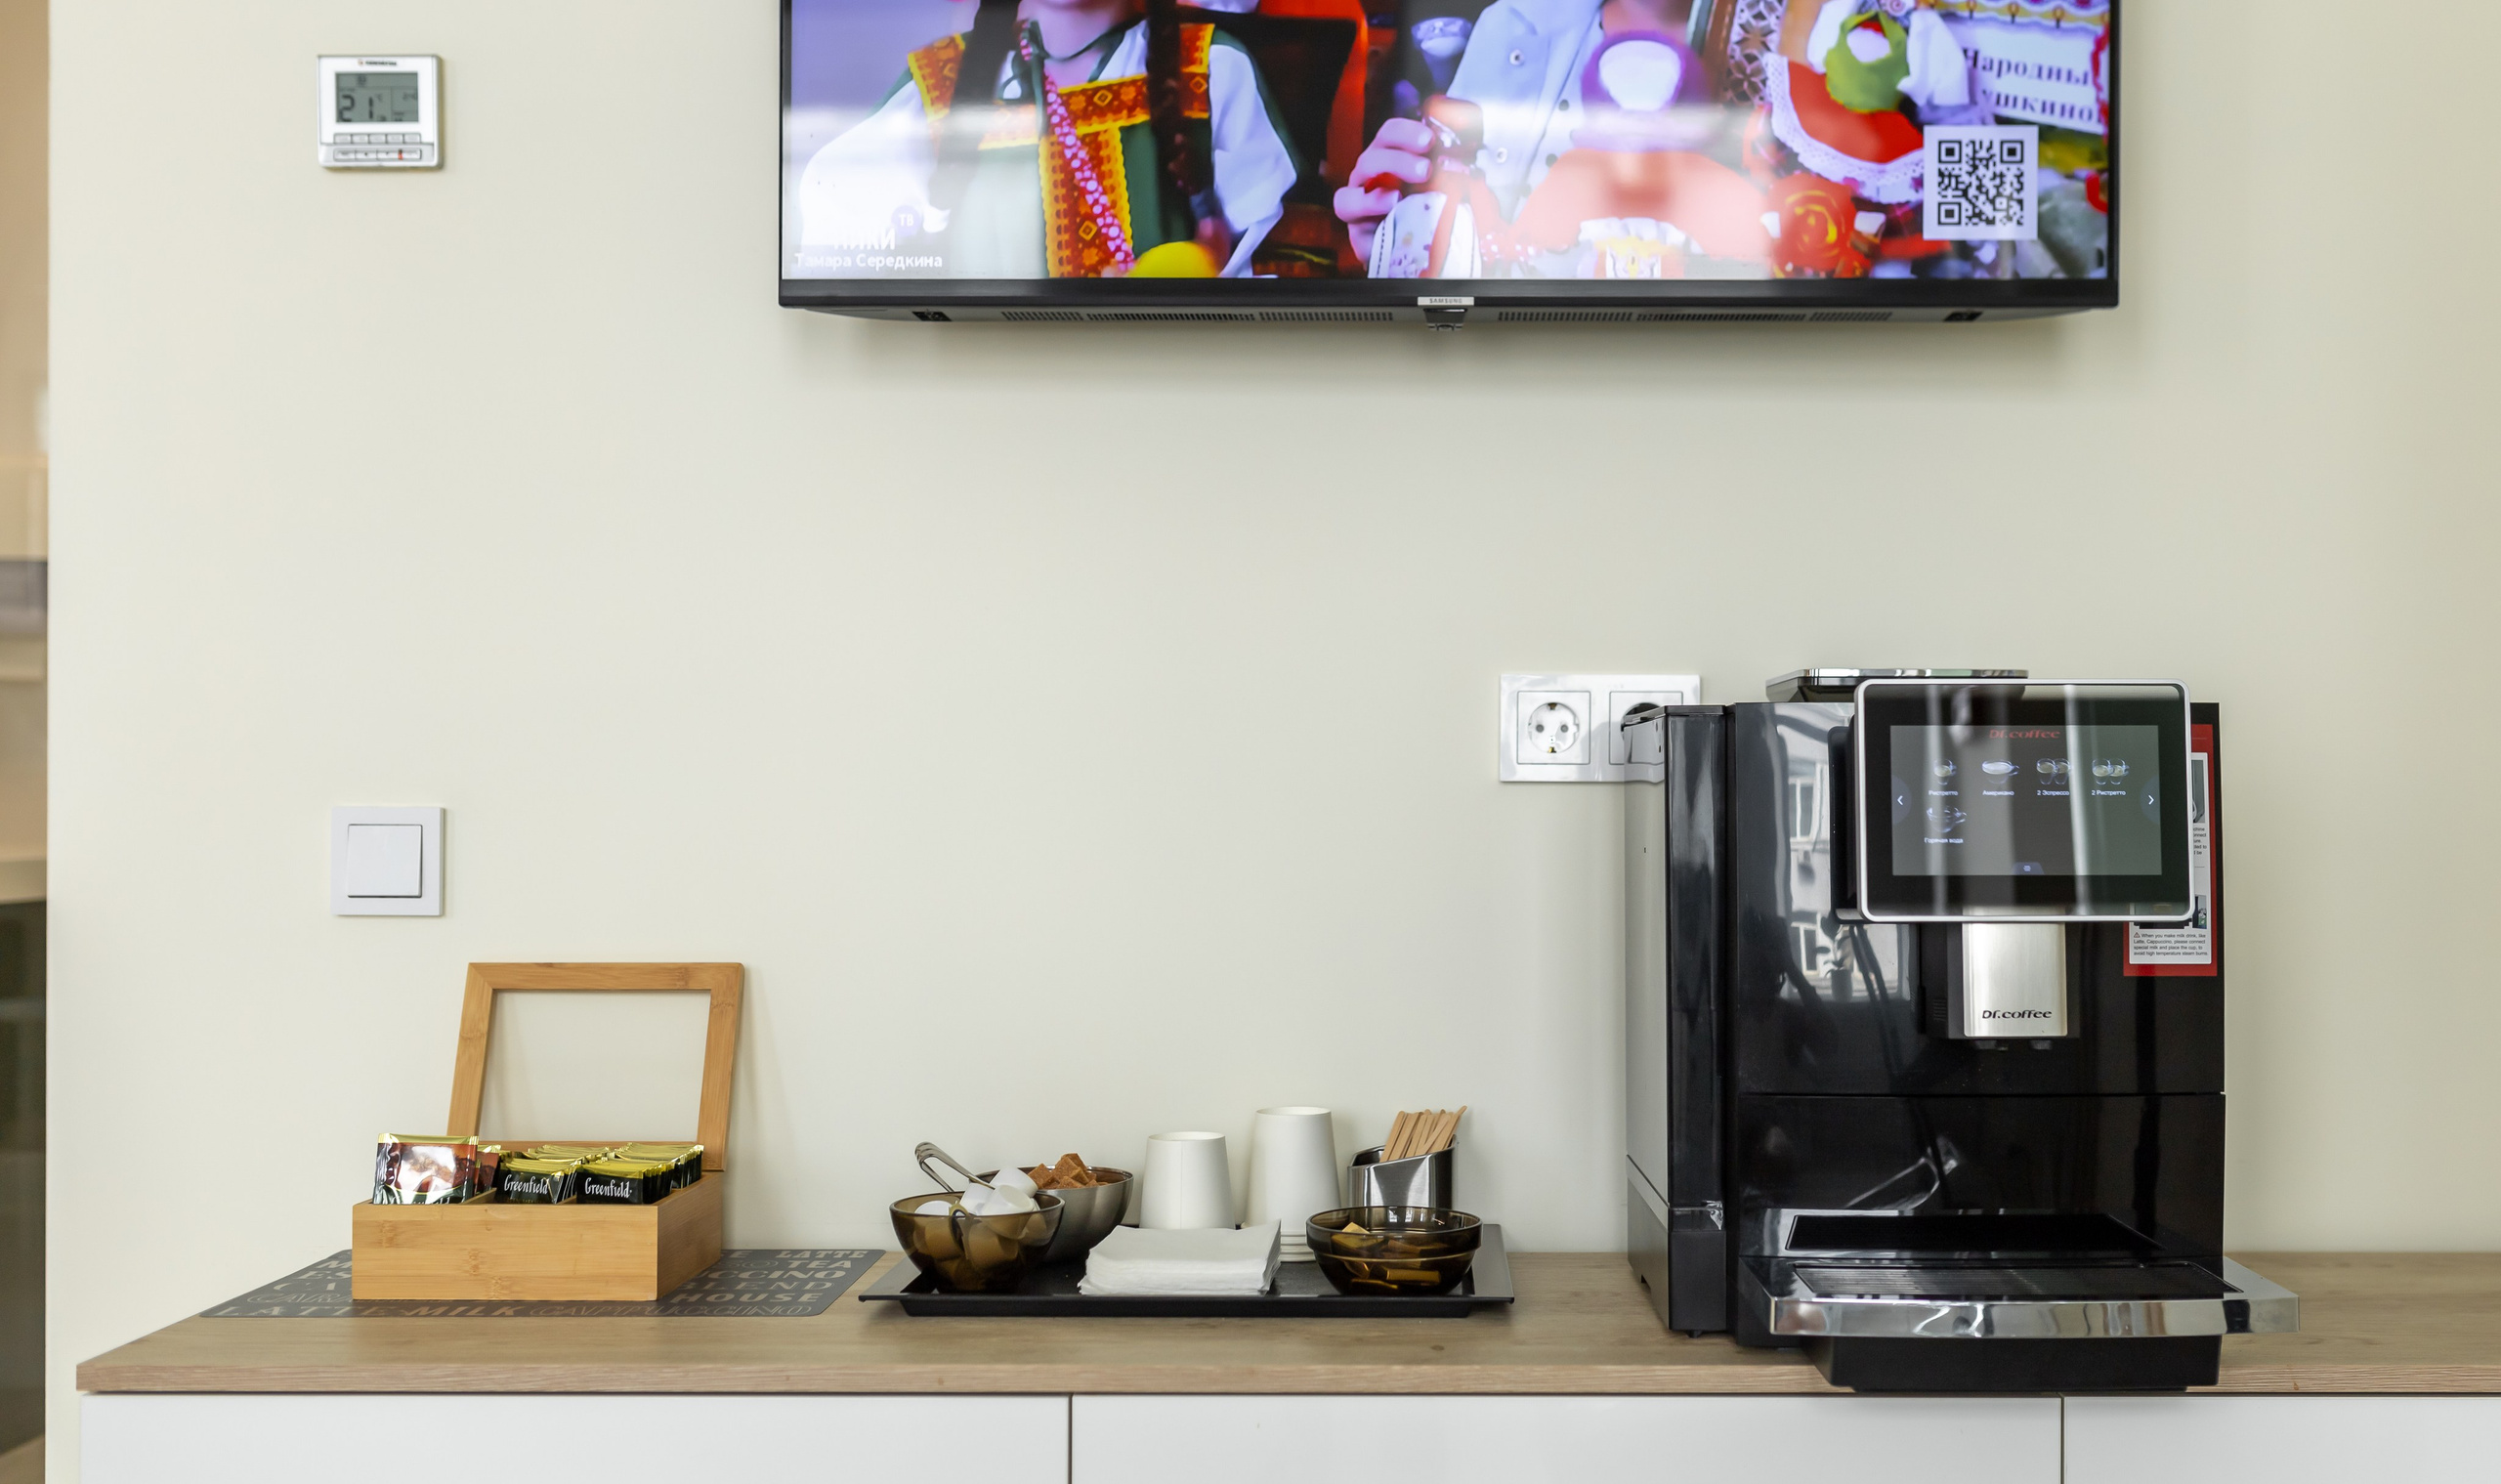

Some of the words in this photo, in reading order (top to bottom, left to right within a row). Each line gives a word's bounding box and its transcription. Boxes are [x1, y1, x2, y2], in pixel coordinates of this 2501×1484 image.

[794, 253, 852, 271] Тамара
[856, 253, 943, 272] Середкина
[1982, 1009, 2053, 1019] Dr.coffee
[504, 1174, 550, 1195] Greenfield
[584, 1177, 631, 1199] Greenfield
[775, 1250, 867, 1258] LATTE
[787, 1260, 852, 1269] TEA
[669, 1293, 824, 1302] HOUSE
[400, 1305, 525, 1316] MILK
[529, 1305, 813, 1316] CAPPUCCINO
